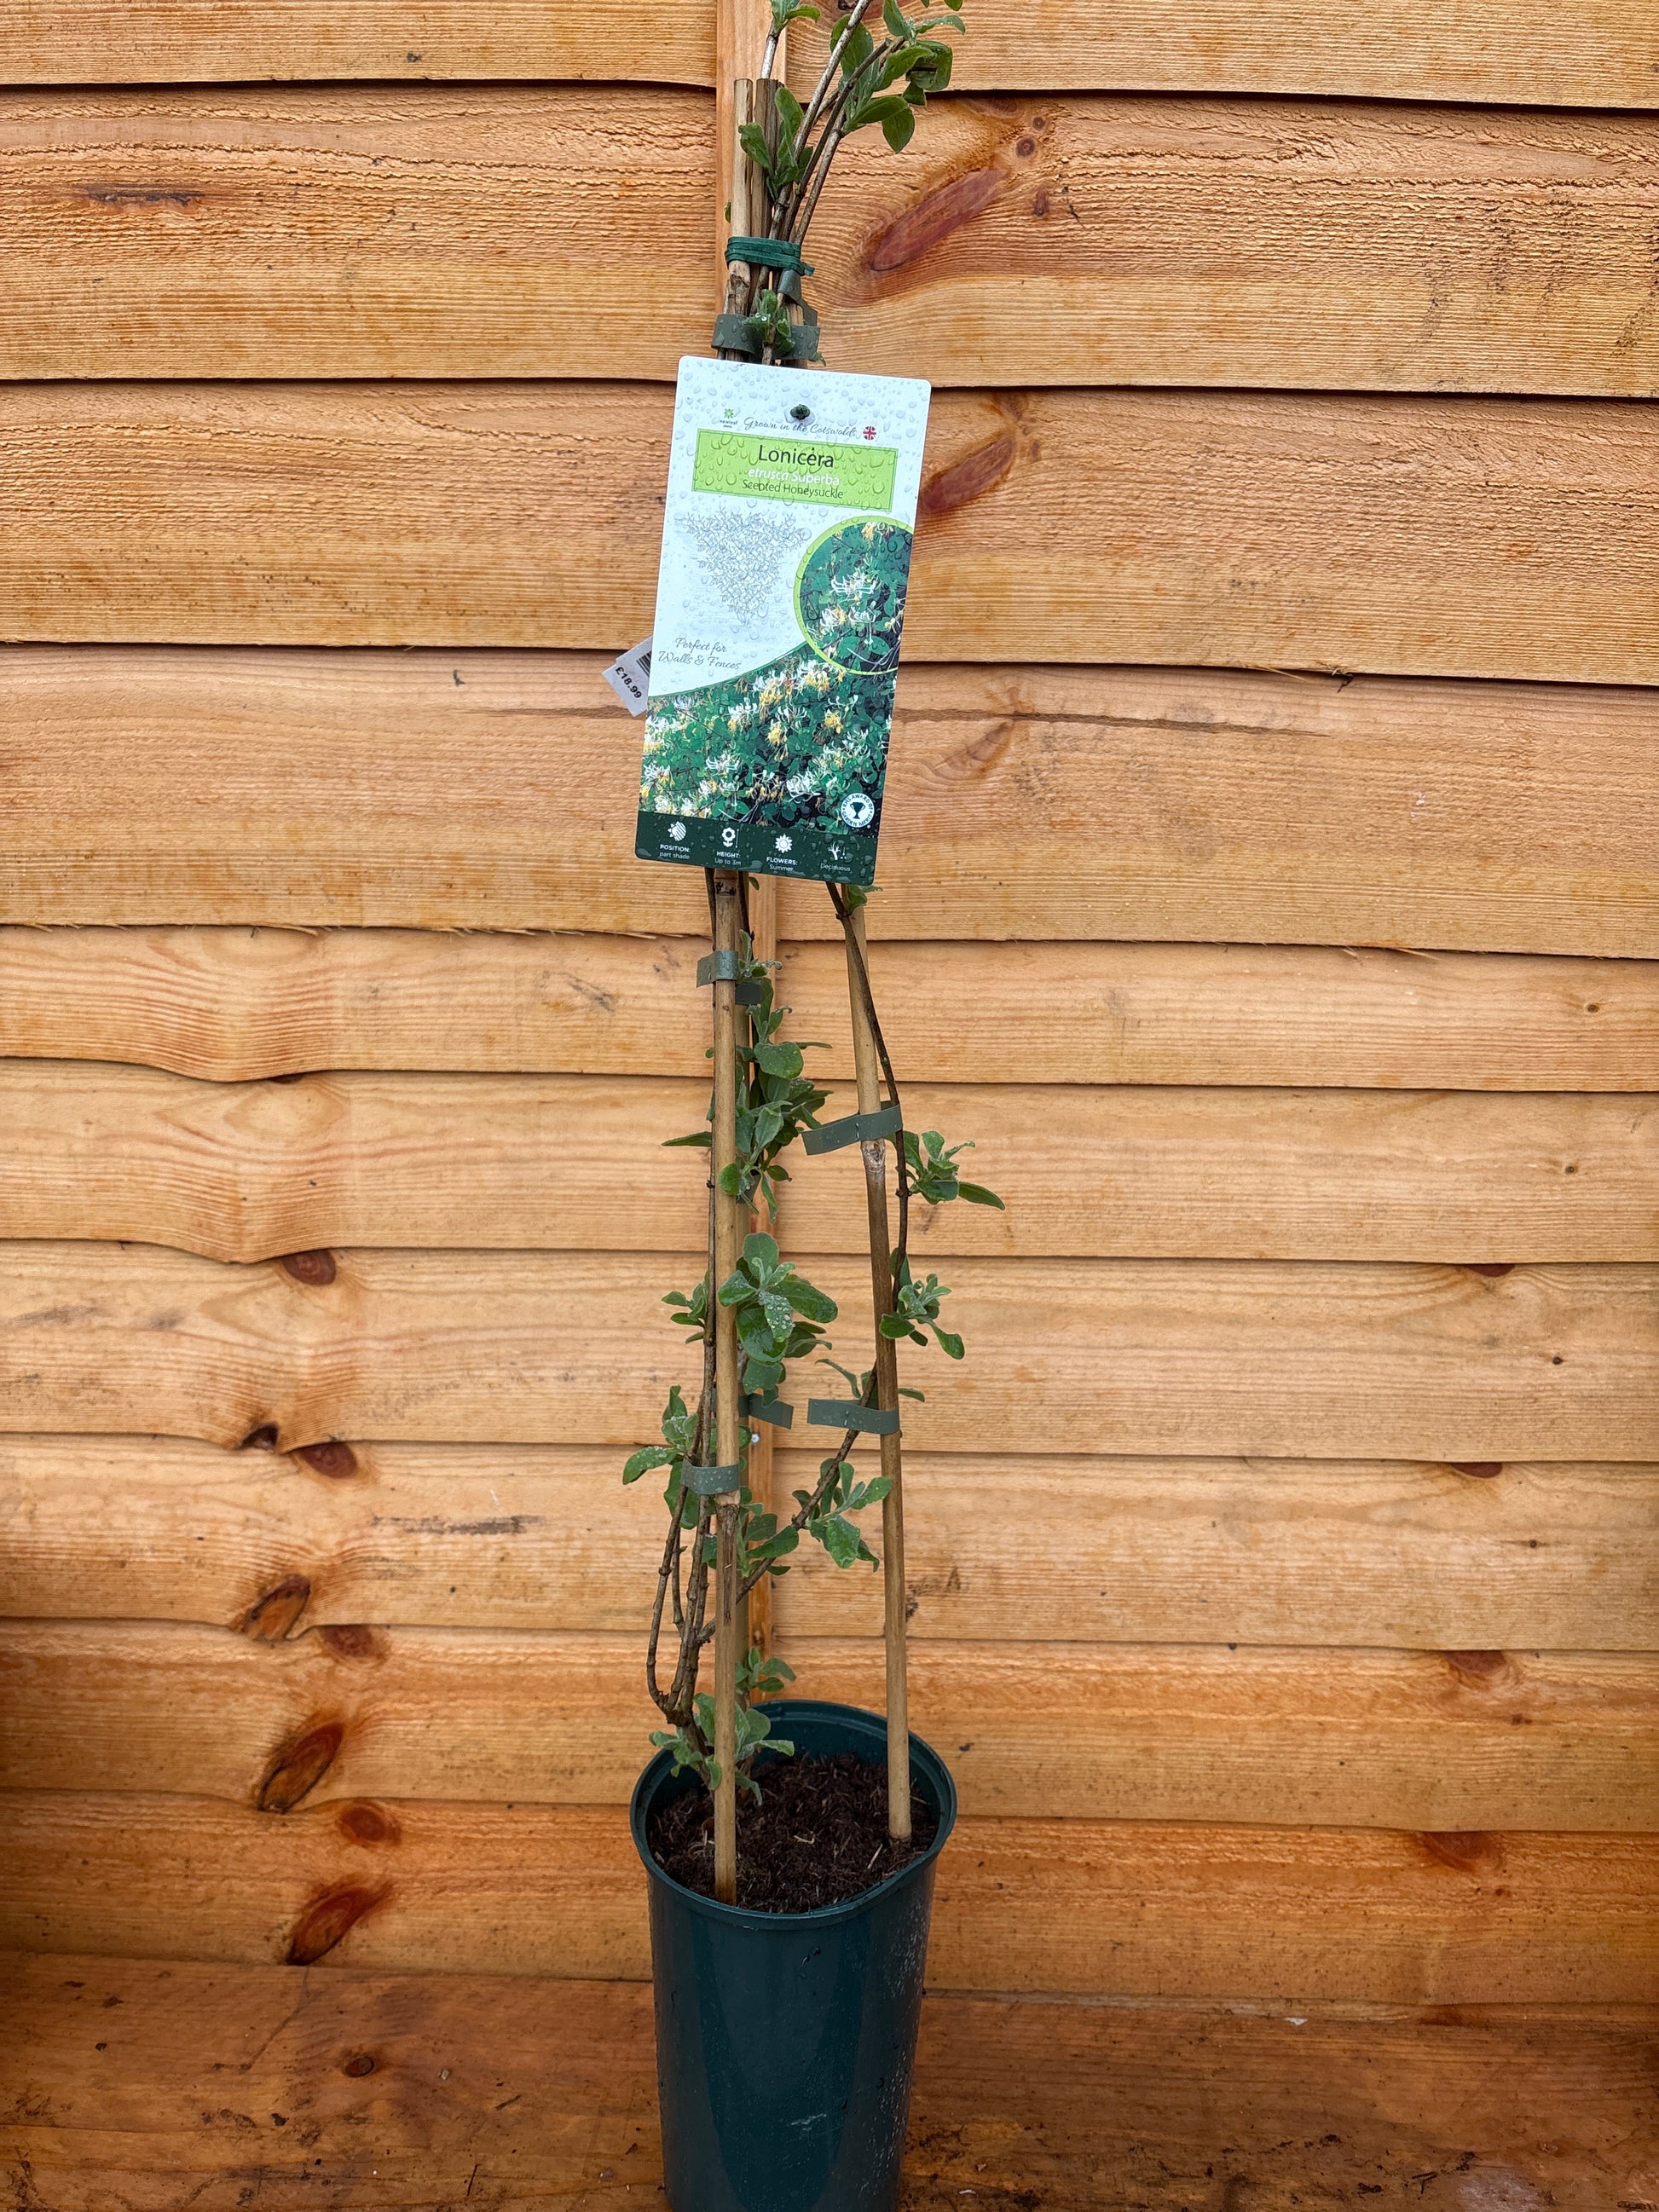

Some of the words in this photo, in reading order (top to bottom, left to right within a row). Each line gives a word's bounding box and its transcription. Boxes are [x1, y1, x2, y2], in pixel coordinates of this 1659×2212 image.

[743, 416, 777, 430] Grown
[792, 423, 807, 432] the
[809, 424, 858, 437] Cotswolds
[759, 444, 835, 468] Lonicera
[748, 468, 789, 481] etrusca
[791, 471, 840, 485] Superba
[783, 483, 844, 499] Honeysuckle
[674, 637, 711, 653] Perfect
[711, 640, 727, 656] for
[658, 650, 693, 665] Walls
[694, 655, 704, 665] &
[707, 656, 742, 670] Fences
[615, 667, 642, 698] £18.99
[842, 797, 852, 807] RHS
[852, 794, 870, 803] AWARD
[660, 844, 691, 852] POSITION:
[766, 857, 798, 865] FLOWERS:
[820, 863, 851, 872] Deciduous
